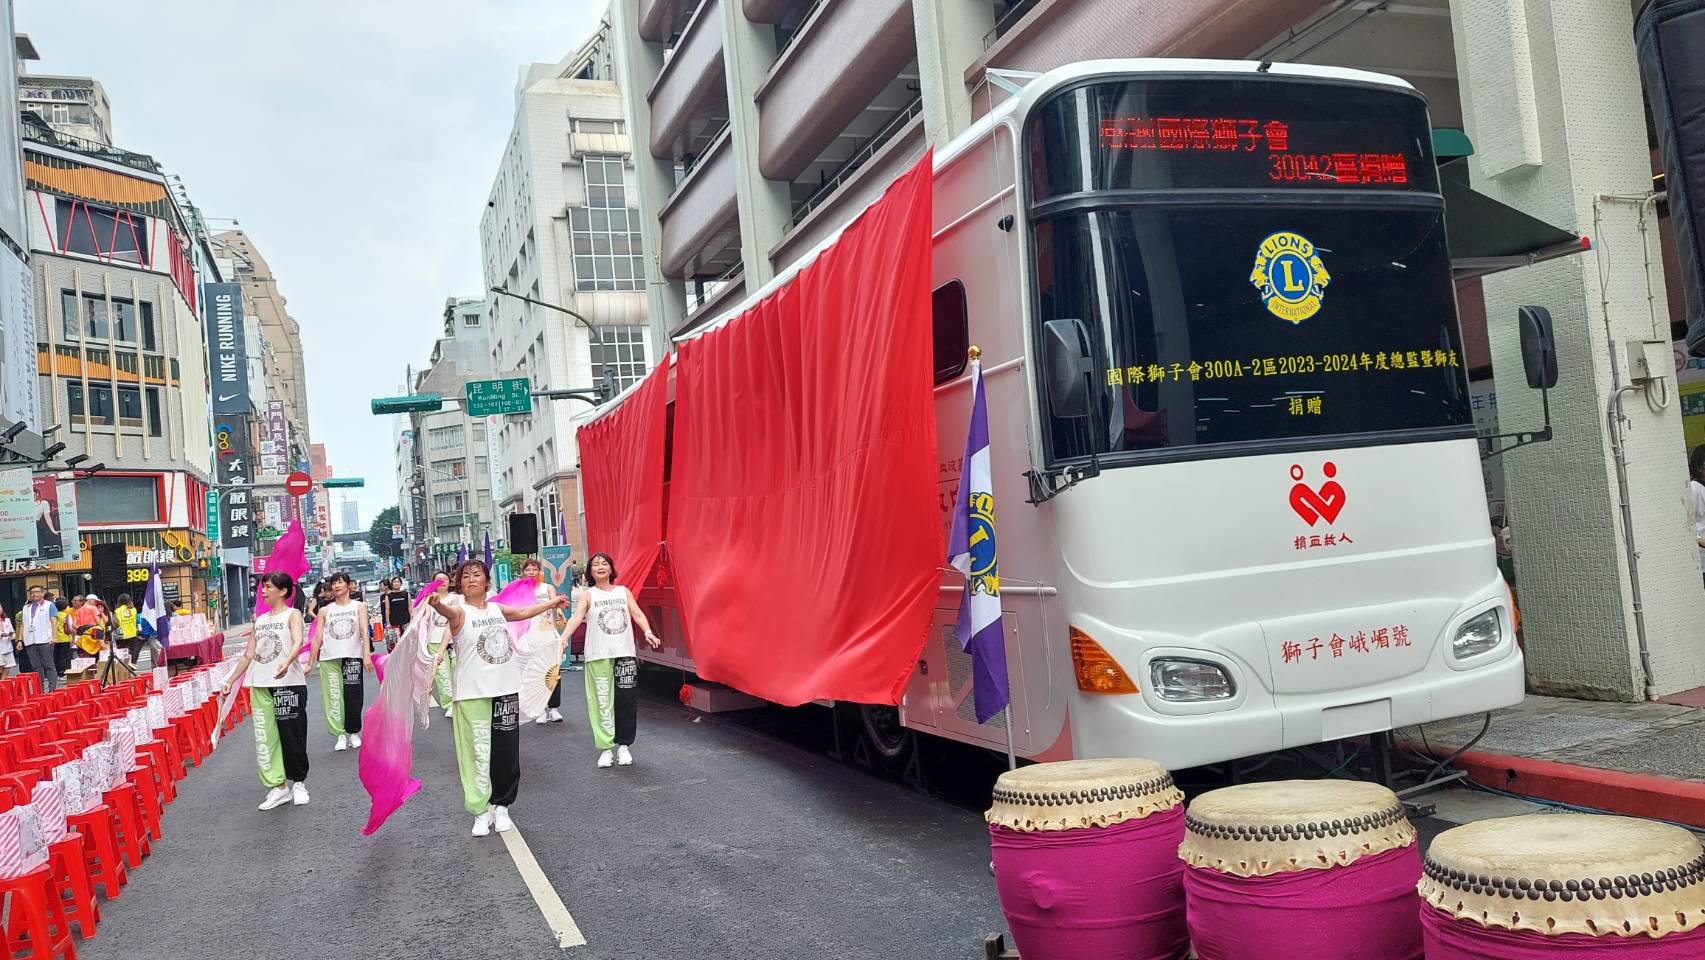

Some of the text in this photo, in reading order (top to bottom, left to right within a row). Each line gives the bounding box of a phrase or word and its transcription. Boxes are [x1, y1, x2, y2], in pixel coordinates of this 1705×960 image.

[1264, 235, 1310, 254] LIONS
[1280, 260, 1305, 291] L
[1271, 298, 1317, 317] INTERNATIONAL
[215, 294, 237, 382] NIKE RUNNING
[473, 380, 523, 394] 昆明街
[1288, 395, 1322, 416] 捐贈
[1281, 624, 1412, 664] 獅子會峨嵋號
